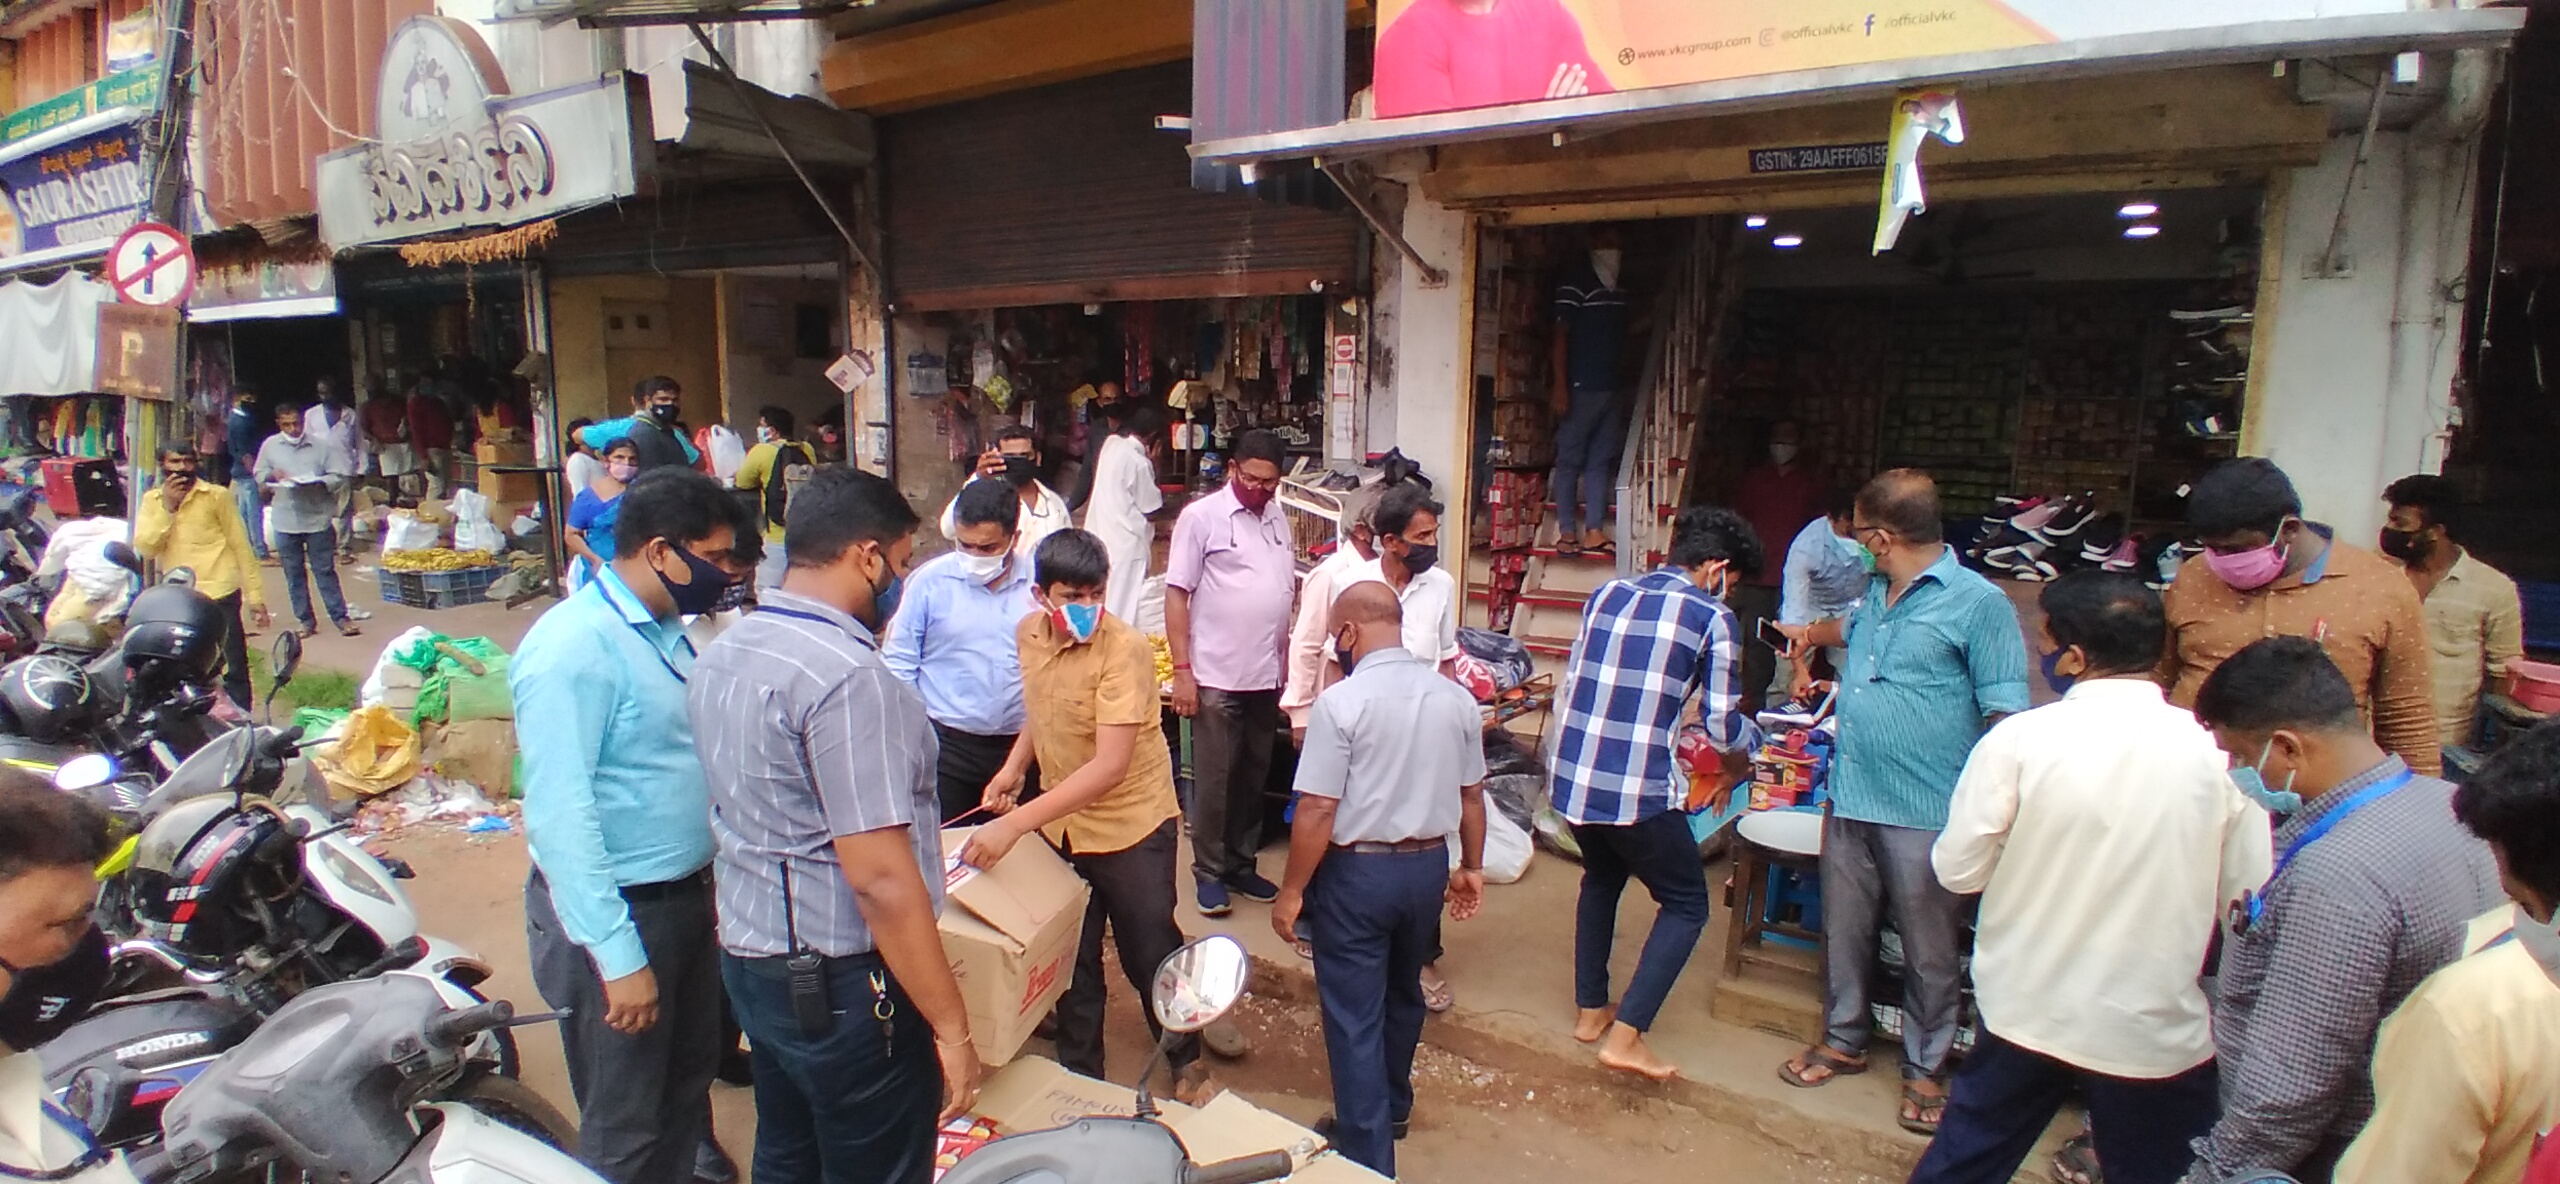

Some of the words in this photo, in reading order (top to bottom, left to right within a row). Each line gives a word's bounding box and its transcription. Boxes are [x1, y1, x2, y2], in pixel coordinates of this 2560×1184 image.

[1637, 36, 1751, 59] www.vkcgroup.com
[1781, 22, 1854, 42] @officialvkc
[1756, 151, 1797, 170] GSTIN:
[15, 160, 148, 228] SAURASHTR
[115, 1030, 209, 1060] HONDA
